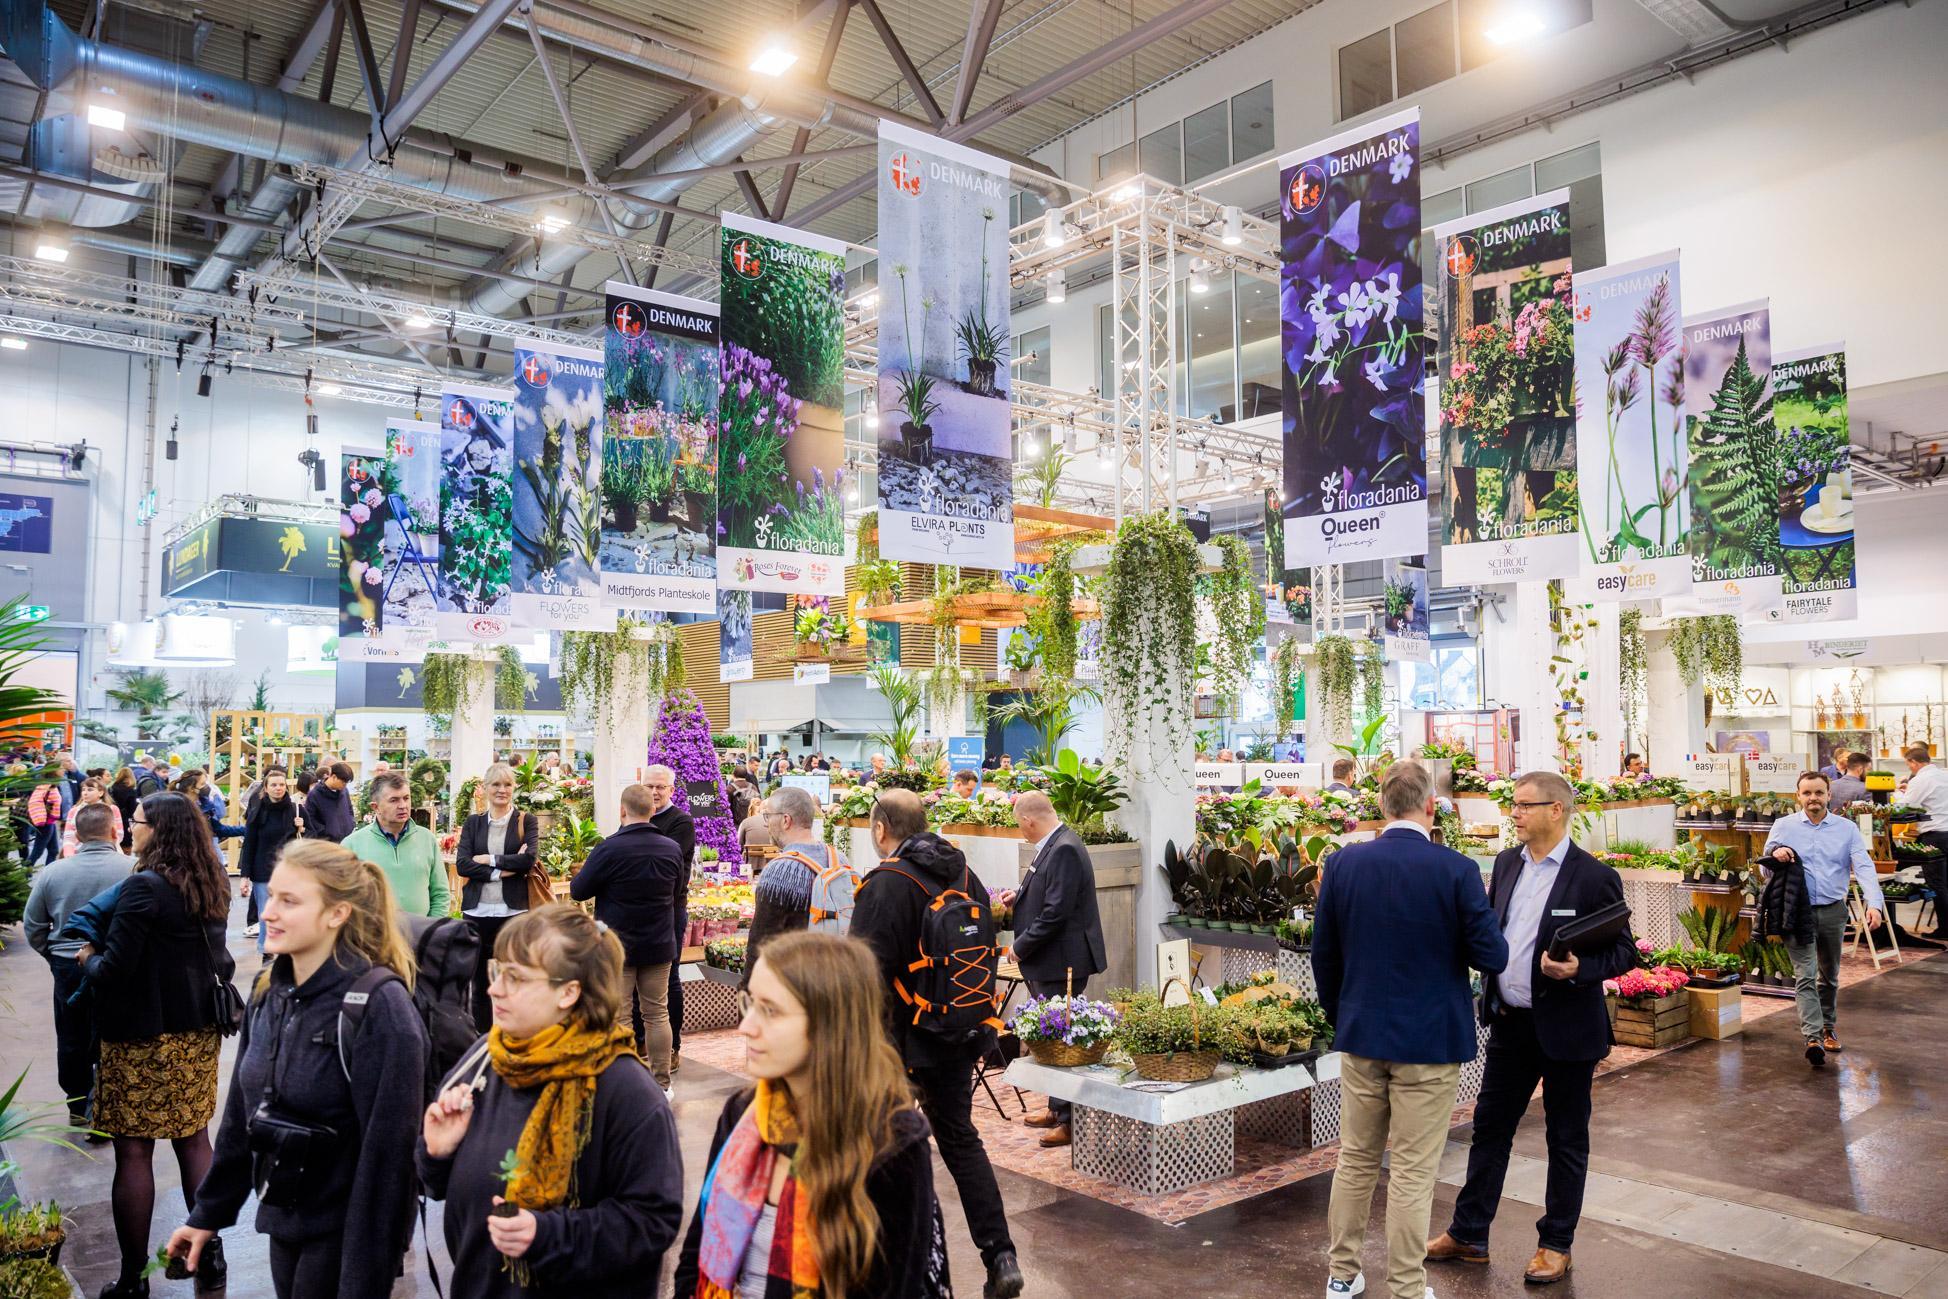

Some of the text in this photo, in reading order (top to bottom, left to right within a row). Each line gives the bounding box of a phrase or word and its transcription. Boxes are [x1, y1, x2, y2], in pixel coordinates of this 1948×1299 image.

[1330, 133, 1410, 177] DENMARK
[931, 162, 1002, 199] DENMARK
[1484, 212, 1562, 247] DENMARK
[770, 246, 838, 277] DENMARK
[1600, 269, 1672, 300] DENMARK
[651, 308, 712, 333] DENMARK
[1694, 317, 1761, 343] DENMARK
[556, 361, 605, 379] DENMAR
[1772, 359, 1837, 381] DENMARK
[480, 403, 514, 416] DENM
[1338, 481, 1419, 510] floradania
[936, 494, 1007, 522] floradania
[911, 516, 945, 531] ELVIRA
[1493, 515, 1572, 539] floradania
[771, 532, 839, 554] floradania
[648, 559, 711, 577] floradania
[754, 562, 801, 575] Roses Forever
[1493, 567, 1525, 576] FLOWERS
[1707, 562, 1775, 580] floradania
[1597, 572, 1656, 592] easycare
[1785, 577, 1850, 594] floradania
[608, 584, 711, 601] Midtfjords Planteskole
[477, 601, 511, 614] florad
[540, 601, 589, 613] FLOWERS
[1786, 597, 1832, 608] FAIRYTALE
[1791, 606, 1828, 615] FLOWERS
[550, 609, 579, 622] for you
[1195, 770, 1220, 779] ueen
[1264, 769, 1300, 782] Queen
[1695, 761, 1729, 772] easycar
[1758, 761, 1797, 772] easycare
